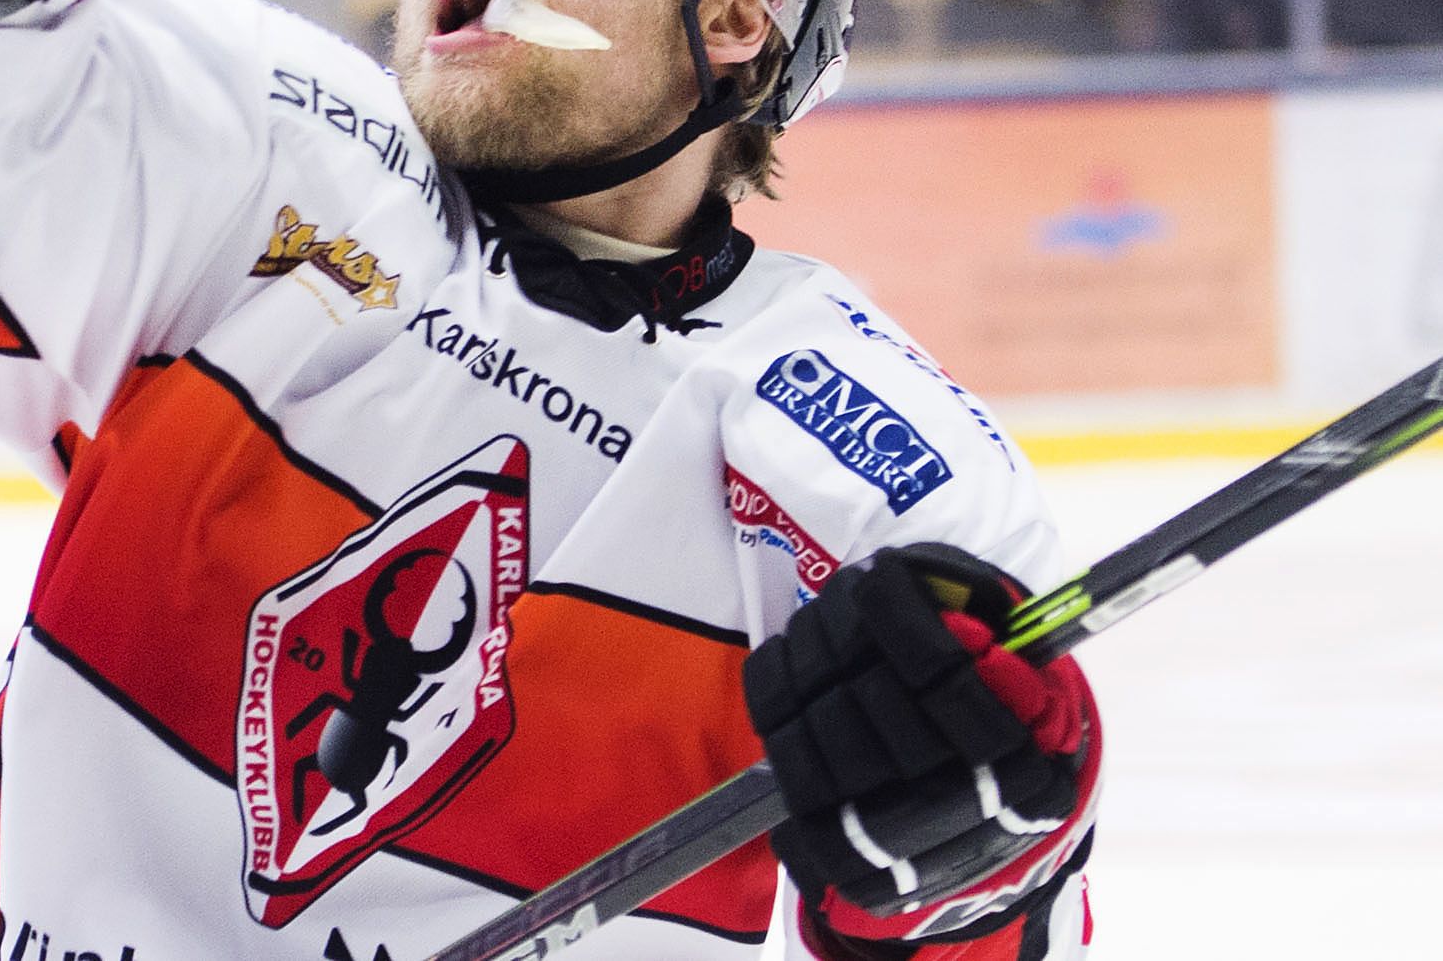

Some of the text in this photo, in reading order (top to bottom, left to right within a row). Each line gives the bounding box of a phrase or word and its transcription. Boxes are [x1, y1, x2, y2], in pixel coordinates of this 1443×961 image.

[761, 375, 922, 501] BRATTBERG
[815, 376, 945, 478] MCT
[286, 636, 325, 672] 20
[244, 613, 278, 872] HOCKEYKLUBB
